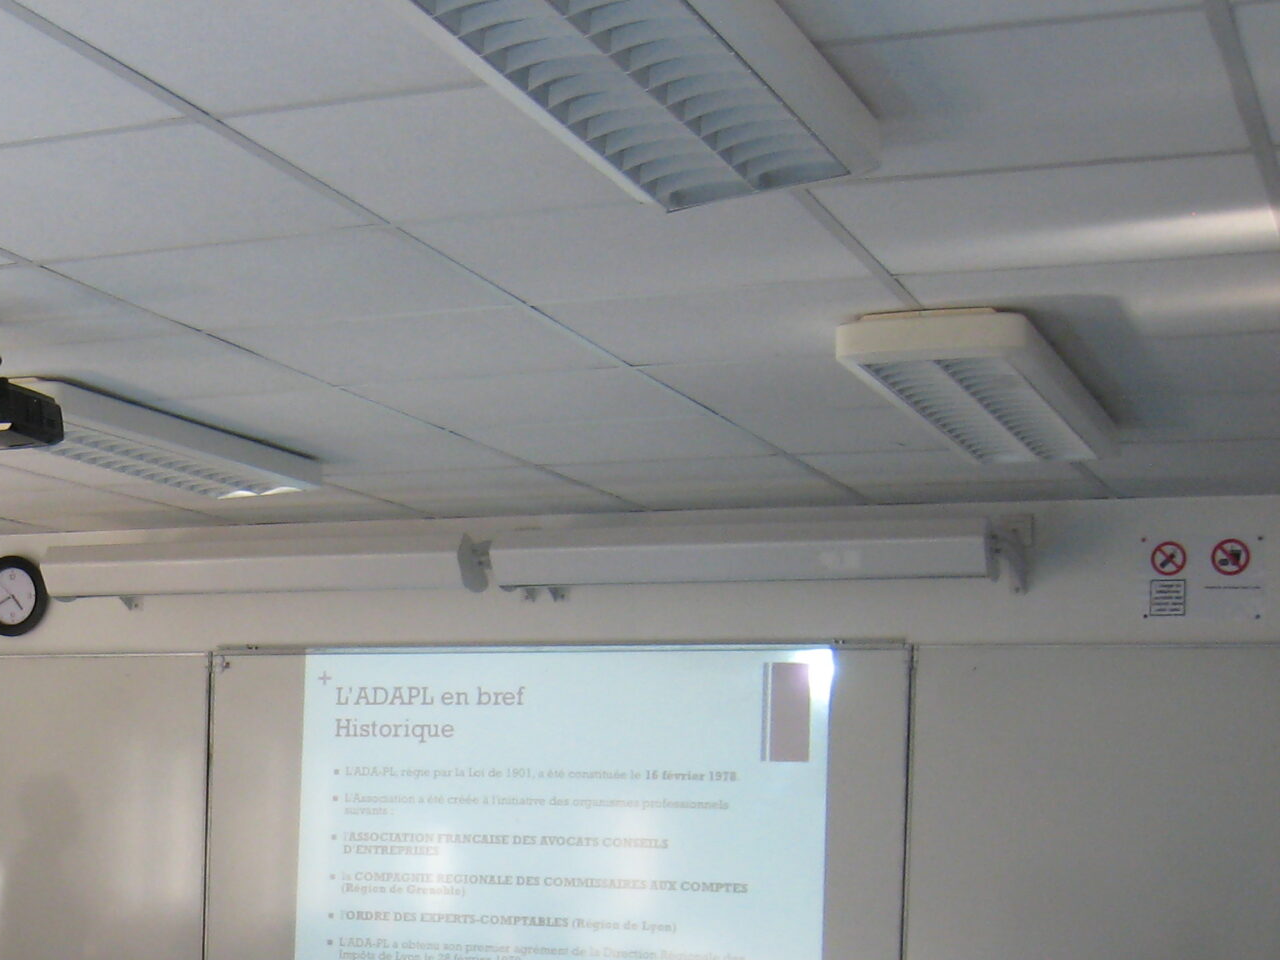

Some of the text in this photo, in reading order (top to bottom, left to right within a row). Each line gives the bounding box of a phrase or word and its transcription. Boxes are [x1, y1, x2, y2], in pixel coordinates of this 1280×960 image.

[335, 686, 526, 706] L'ADAPL en bref
[335, 718, 455, 743] Historique
[434, 769, 452, 780] par
[455, 768, 465, 778] la
[469, 768, 485, 778] Loi
[488, 768, 503, 778] de
[538, 771, 545, 779] a
[547, 769, 564, 779] été
[569, 770, 626, 780] constituée
[630, 770, 641, 780] le
[645, 770, 658, 780] 16
[662, 770, 705, 781] février
[345, 793, 415, 804] L'Association
[428, 795, 444, 804] été
[549, 796, 569, 806] des
[513, 835, 536, 845] DES
[539, 835, 599, 847] AVOCATS
[602, 837, 668, 849] CONSEILS
[355, 872, 433, 884] COMPAGNIE
[516, 875, 540, 886] DES
[544, 876, 648, 890] COMMISSAIRES
[650, 880, 677, 891] AUX
[680, 881, 748, 893] COMPTES
[390, 884, 404, 894] de
[394, 911, 417, 922] DES
[420, 912, 569, 928] EXPERTS-COMPTABLES
[624, 920, 638, 931] de
[642, 921, 677, 934] Lyon)
[378, 951, 392, 960] de
[401, 940, 439, 951] obtenu
[572, 946, 586, 957] de
